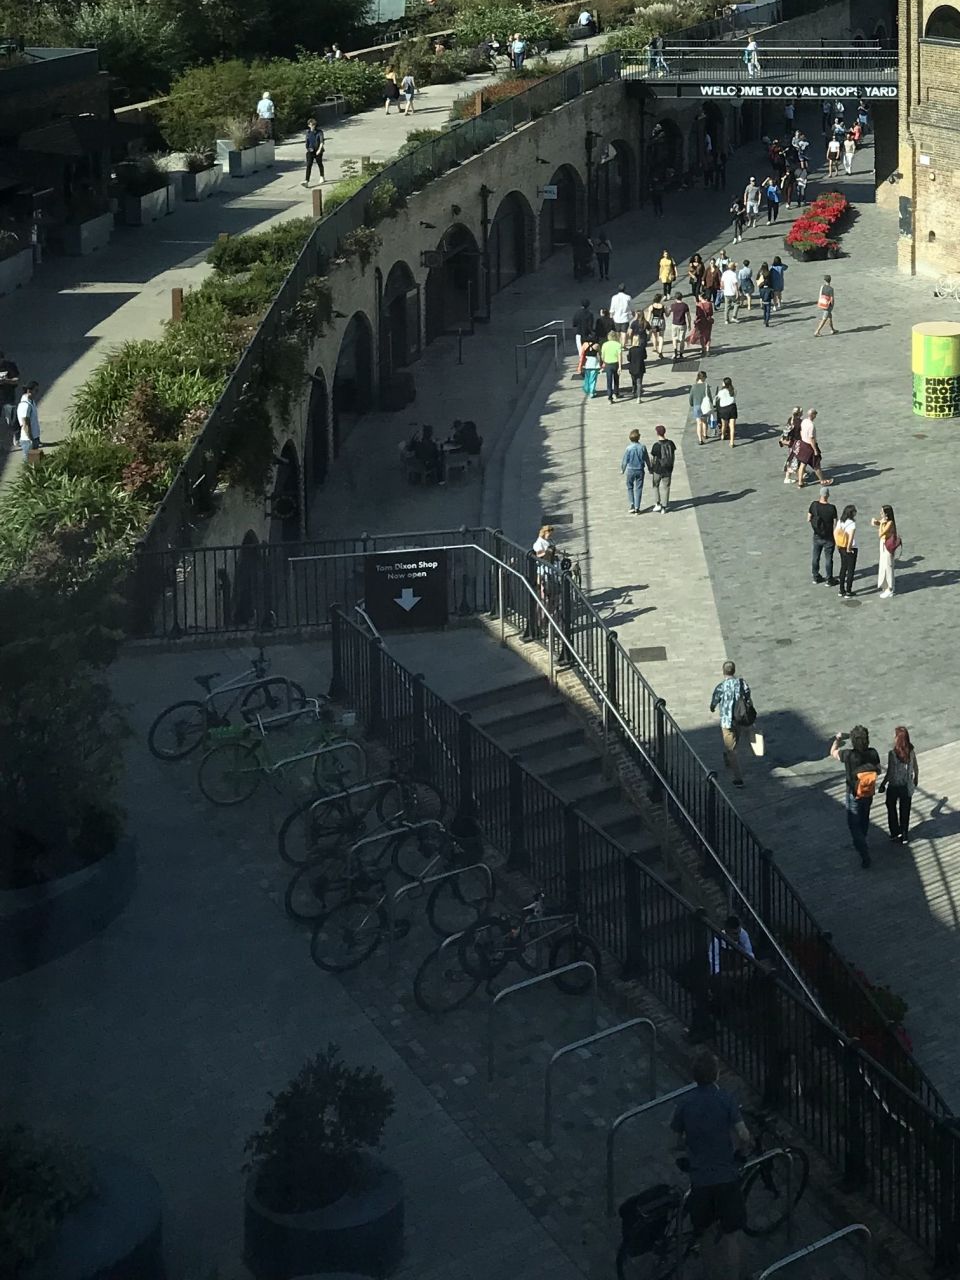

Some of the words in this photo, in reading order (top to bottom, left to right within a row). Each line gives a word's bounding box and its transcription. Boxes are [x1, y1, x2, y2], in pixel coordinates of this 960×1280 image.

[766, 86, 783, 96] TO
[865, 86, 898, 96] YARD
[418, 561, 438, 569] Shop
[387, 572, 405, 580] Now
